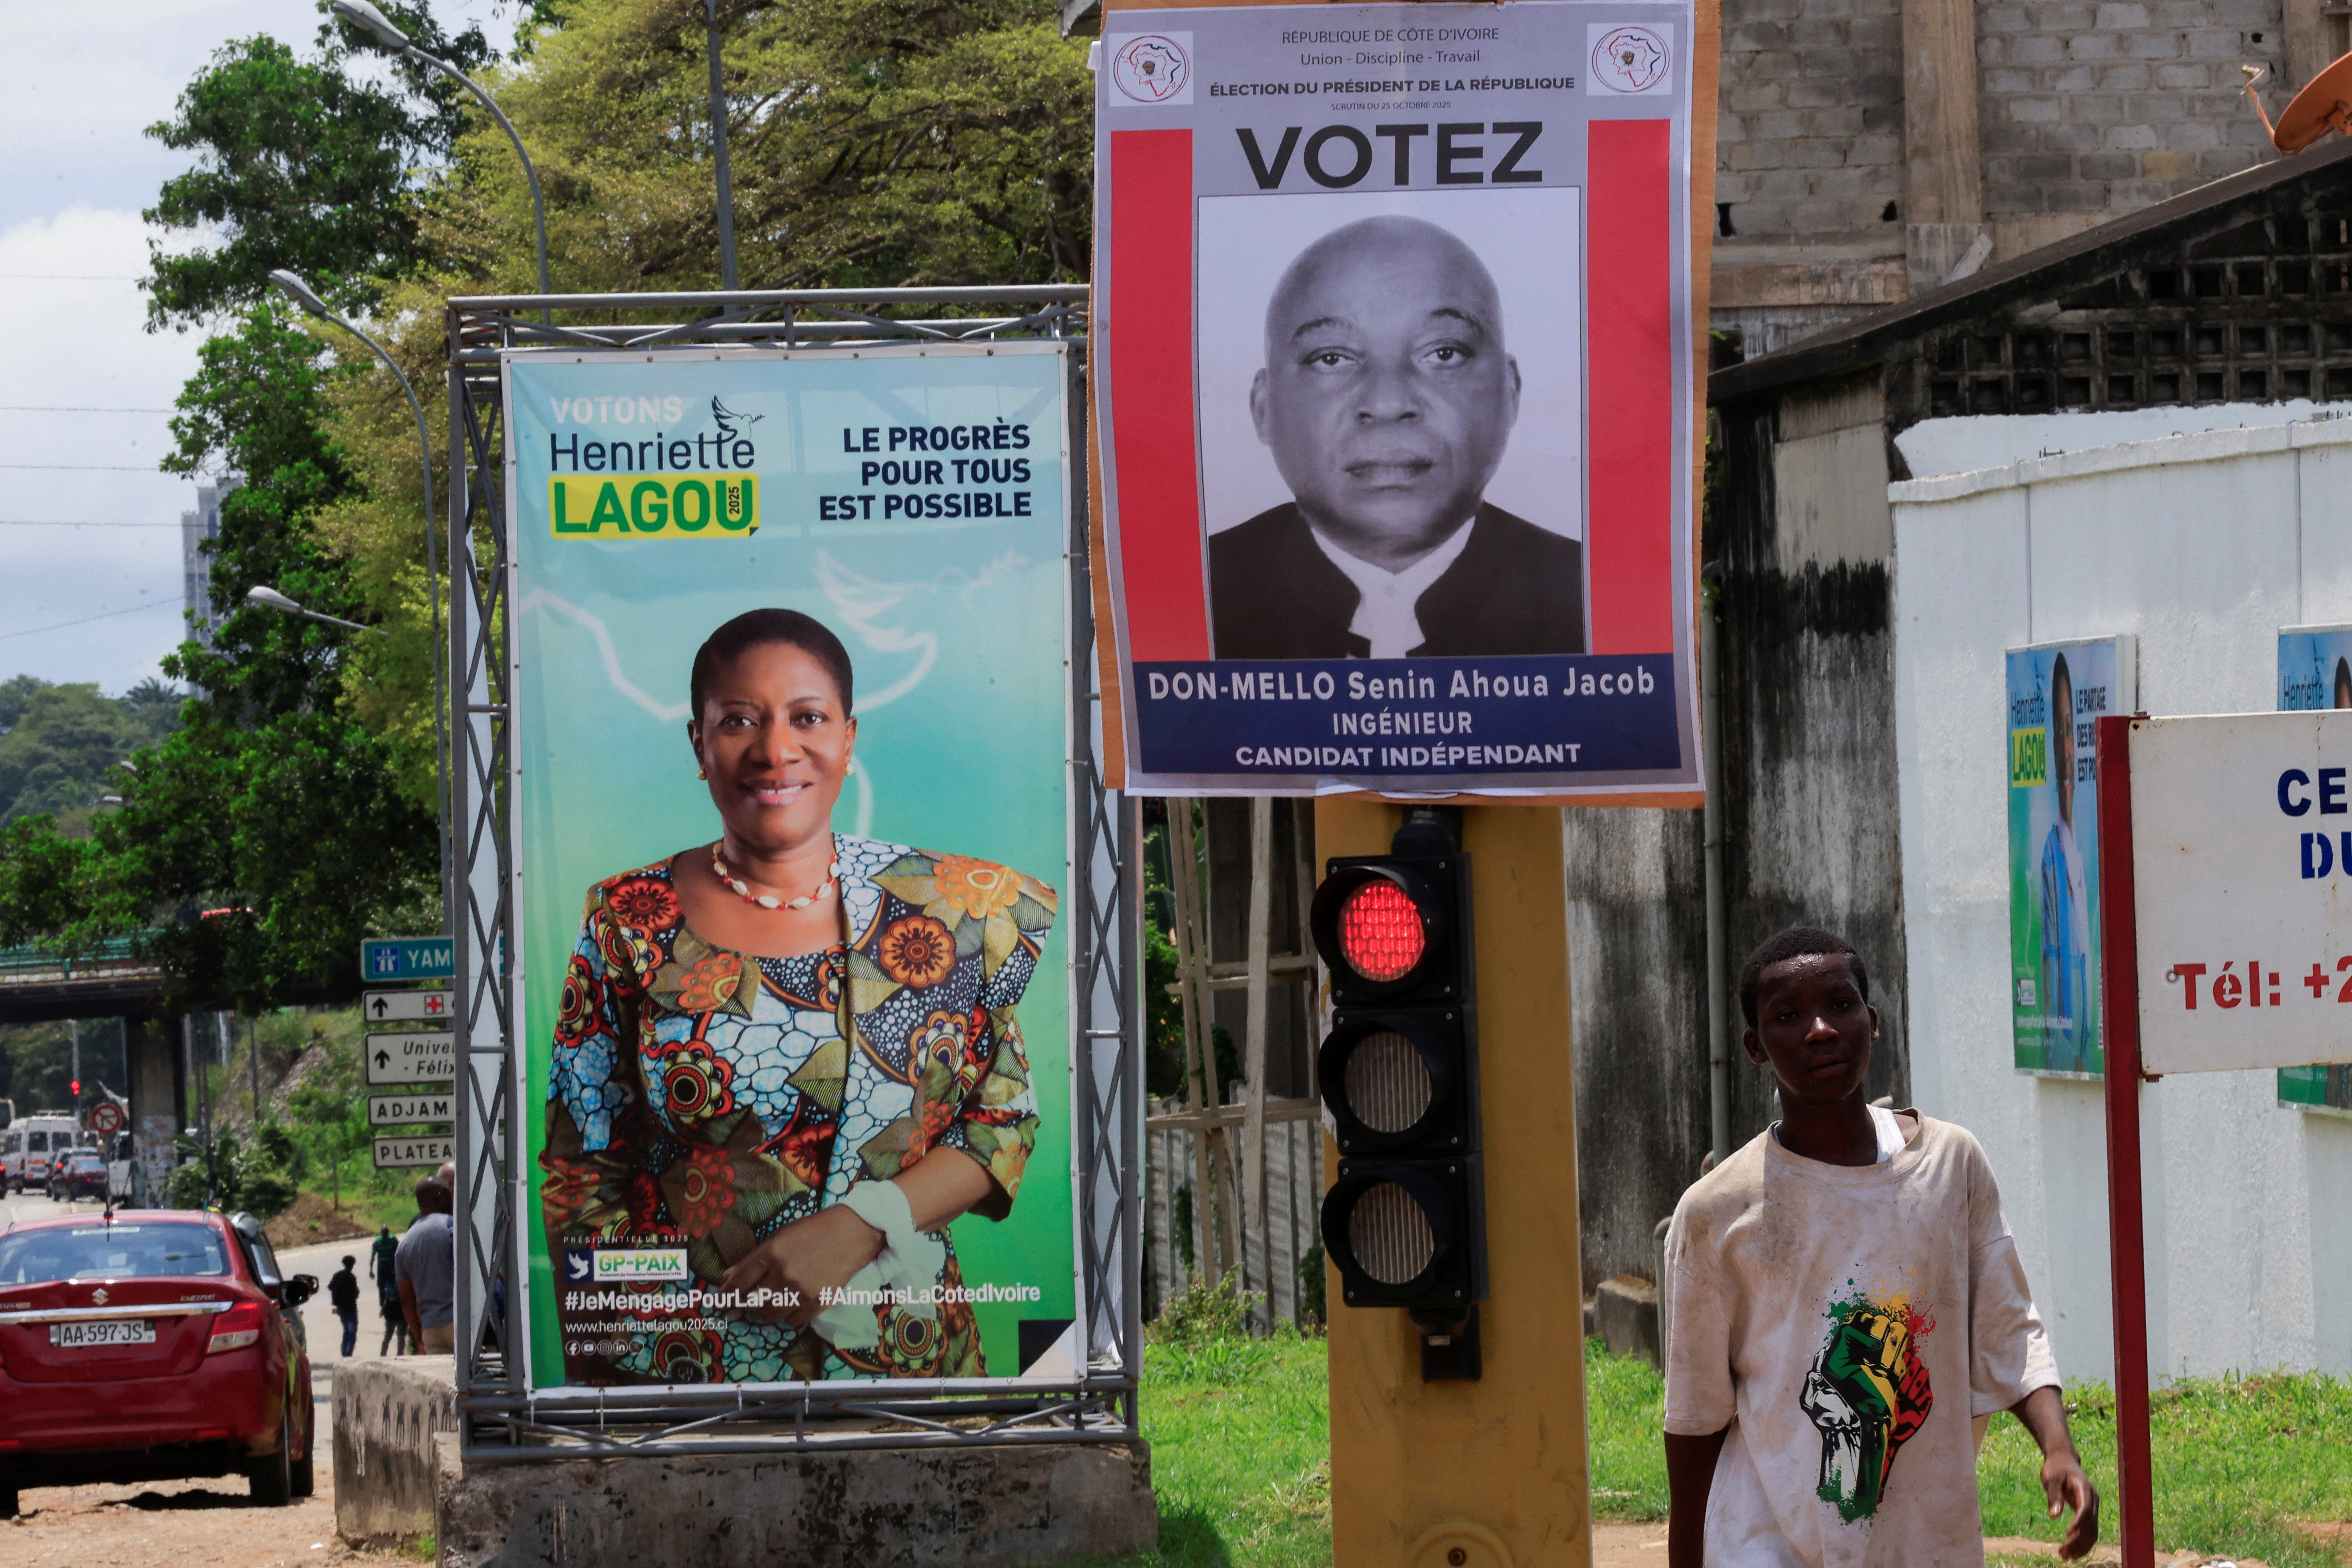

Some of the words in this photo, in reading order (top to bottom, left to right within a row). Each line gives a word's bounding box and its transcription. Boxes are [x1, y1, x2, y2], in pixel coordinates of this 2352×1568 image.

[1283, 30, 1370, 44] RÉPUBLIQUE
[1375, 30, 1393, 41] DE
[1397, 27, 1434, 41] CÔTE
[1439, 28, 1499, 41] D'IVOIRE
[1301, 53, 1342, 65] Union
[1356, 52, 1423, 66] Discipline
[1436, 50, 1480, 62] Travail
[1211, 82, 1289, 96] ÉLECTION
[1294, 82, 1318, 94] DU
[1323, 79, 1414, 93] PRÉSIDENT
[1419, 80, 1440, 92] DE
[1445, 80, 1465, 91] LA
[1470, 76, 1575, 90] RÉPUBLIQUE
[1236, 121, 1543, 189] VOTEZ
[550, 395, 684, 424] VOTONS
[844, 428, 880, 452] LE
[889, 416, 1030, 452] PROGRÈS
[550, 432, 755, 471] Henriette
[862, 460, 944, 486] POUR
[951, 458, 1031, 484] TOUS
[554, 479, 753, 532] LAGOU
[728, 486, 740, 515] 2025
[820, 494, 876, 521] EST
[884, 492, 1032, 520] POSSIBLE
[1149, 672, 1335, 700] DON-MELLO
[1348, 669, 1435, 700] Senin
[1449, 669, 1548, 698] Ahoua
[1563, 665, 1654, 696] Jacob
[2284, 674, 2323, 710] Henriette
[2076, 689, 2083, 714] LE
[1332, 706, 1472, 735] INGÉNIEUR
[1235, 746, 1373, 766] CANDIDAT
[1381, 741, 1581, 766] INDÉPENDANT
[2012, 733, 2045, 782] LAGOU
[2278, 768, 2347, 817] CE
[408, 948, 450, 968] YAM
[2174, 960, 2280, 1010] Tél:
[377, 1101, 448, 1117] ADJAM
[381, 1143, 452, 1160] PLATEA
[664, 1234, 688, 1243] 2025
[599, 1253, 681, 1272] GP-PAIX
[565, 1287, 801, 1314] #JeMengagePourLaPaix
[819, 1283, 1040, 1306] #AimonsLaCotedIvoire
[565, 1317, 728, 1334] www.henriettelagou2025.ci
